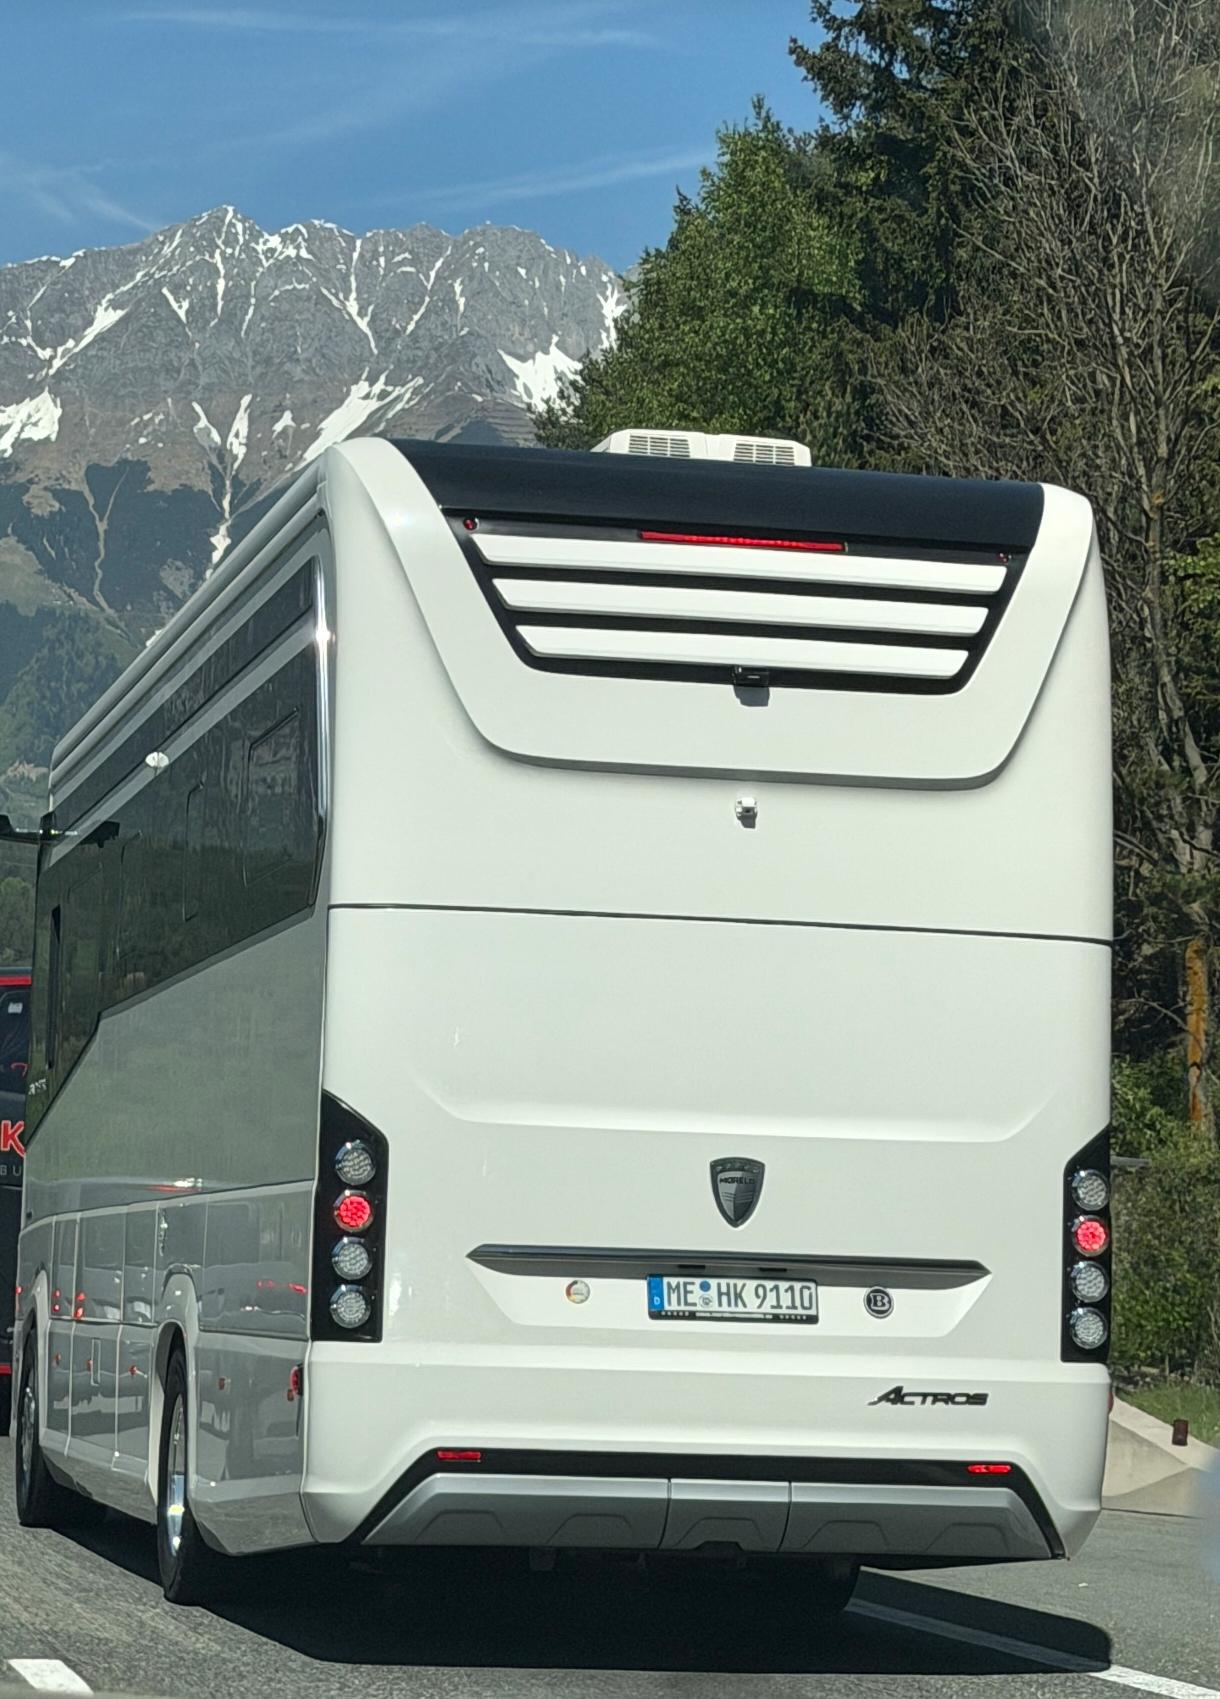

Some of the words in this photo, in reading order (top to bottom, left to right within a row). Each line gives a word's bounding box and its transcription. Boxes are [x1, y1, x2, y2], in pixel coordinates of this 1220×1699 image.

[666, 1281, 698, 1307] ME
[717, 1282, 748, 1309] HK
[754, 1283, 813, 1311] 9110
[867, 1385, 989, 1406] ACTROS
